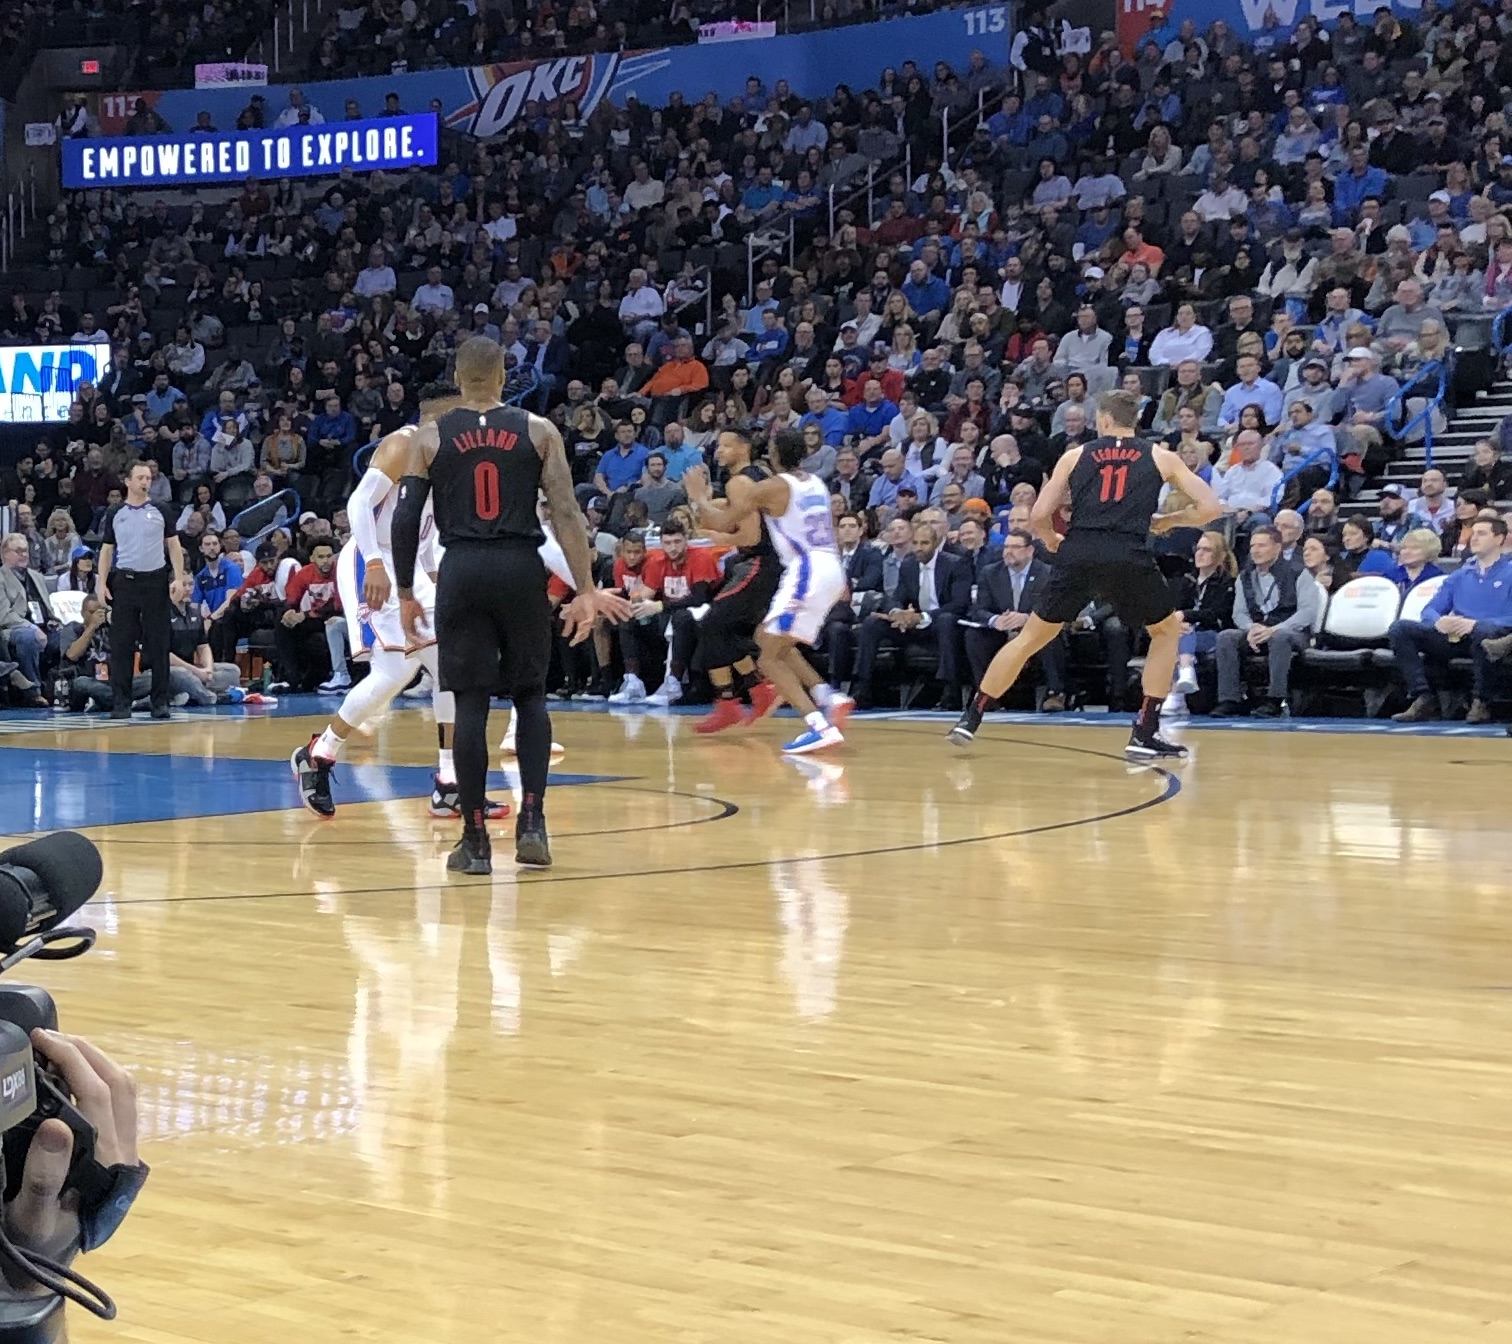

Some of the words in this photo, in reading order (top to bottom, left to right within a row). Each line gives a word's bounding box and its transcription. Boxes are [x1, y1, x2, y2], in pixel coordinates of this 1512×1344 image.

[963, 6, 1007, 37] 113
[82, 139, 250, 179] EMPOWERED
[261, 136, 291, 172] TO
[301, 124, 424, 168] EXPLORE.
[452, 428, 520, 454] LILLARD
[473, 461, 501, 522] 0
[1100, 464, 1128, 503] 11
